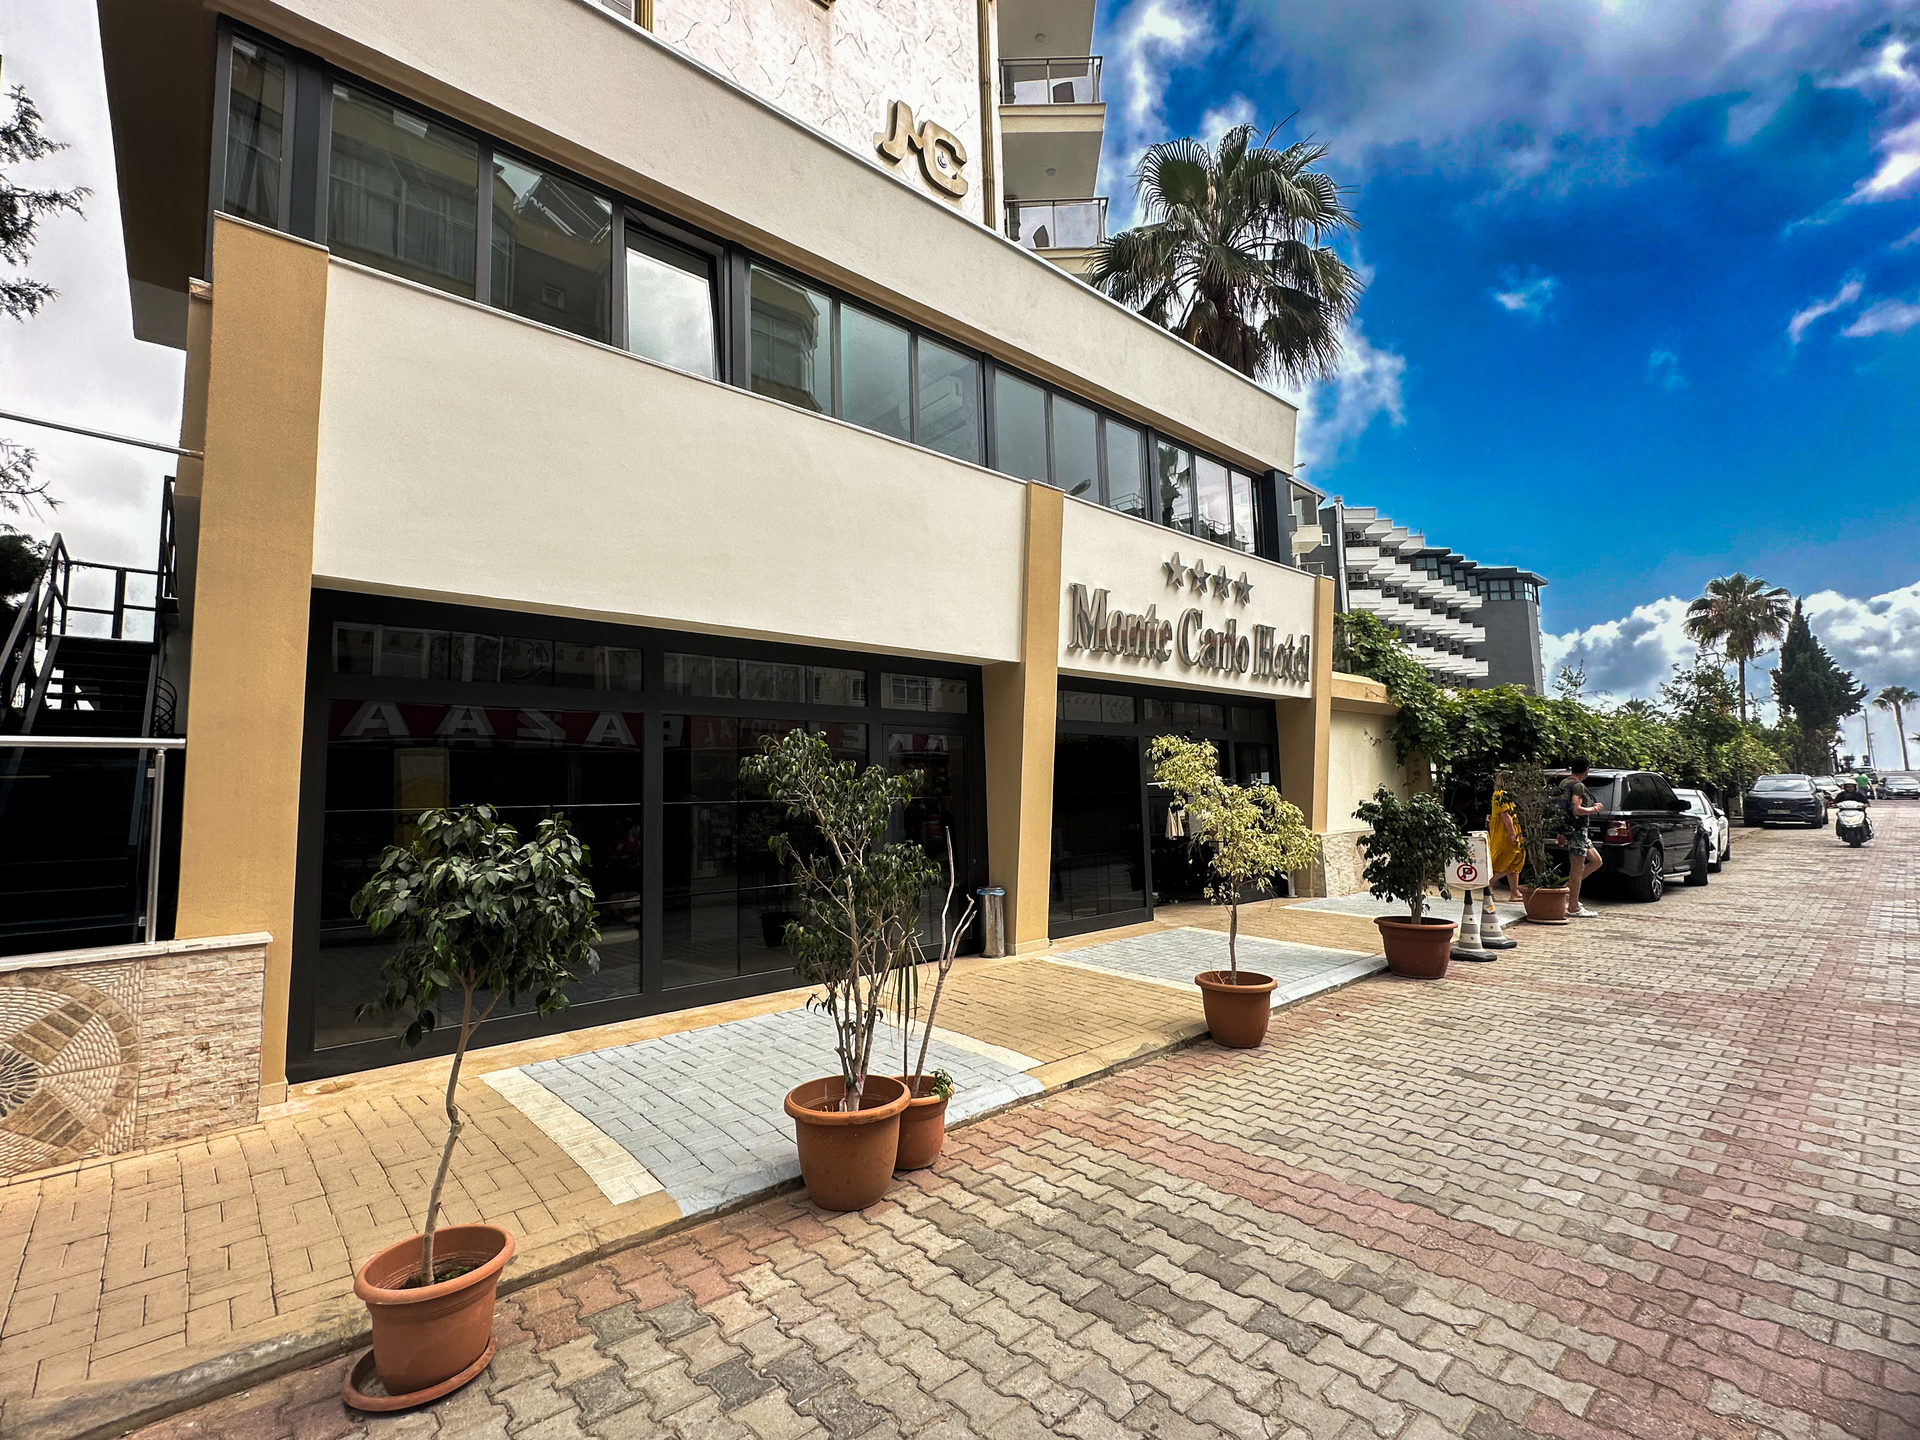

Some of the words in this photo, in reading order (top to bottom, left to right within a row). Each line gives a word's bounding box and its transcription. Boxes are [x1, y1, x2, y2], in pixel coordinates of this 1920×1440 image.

[1067, 583, 1173, 662] Monte
[1177, 607, 1250, 674] Carlo
[1251, 623, 1311, 683] Hotel
